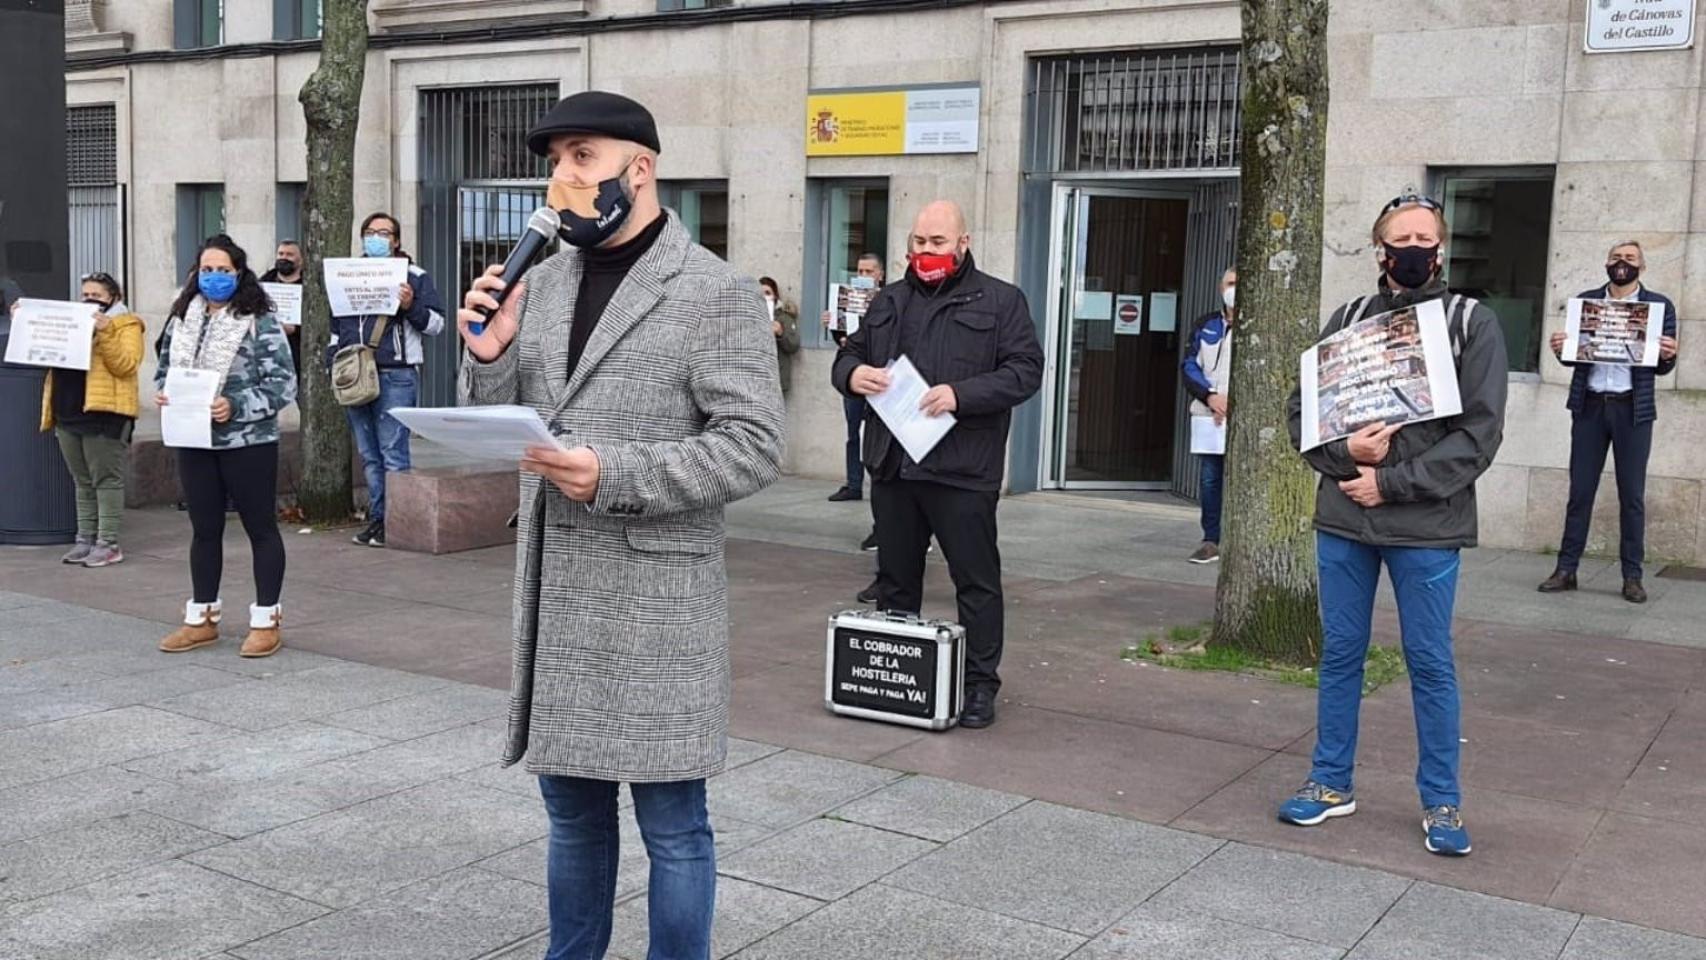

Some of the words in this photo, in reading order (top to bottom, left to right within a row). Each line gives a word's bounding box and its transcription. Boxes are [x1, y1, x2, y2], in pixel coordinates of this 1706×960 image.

[1611, 10, 1627, 22] de
[1629, 9, 1683, 21] Cánovas
[1604, 28, 1623, 40] del
[1625, 25, 1674, 38] Castillo
[849, 638, 862, 650] EL
[864, 640, 923, 658] COBRADOR
[869, 655, 884, 667] DE
[886, 657, 900, 669] LA
[852, 666, 917, 686] HOSTELERIA
[841, 682, 858, 693] SEPE
[859, 685, 878, 696] PAGA
[880, 688, 885, 696] Y
[886, 689, 905, 700] PAGA
[907, 688, 927, 704] YA!
